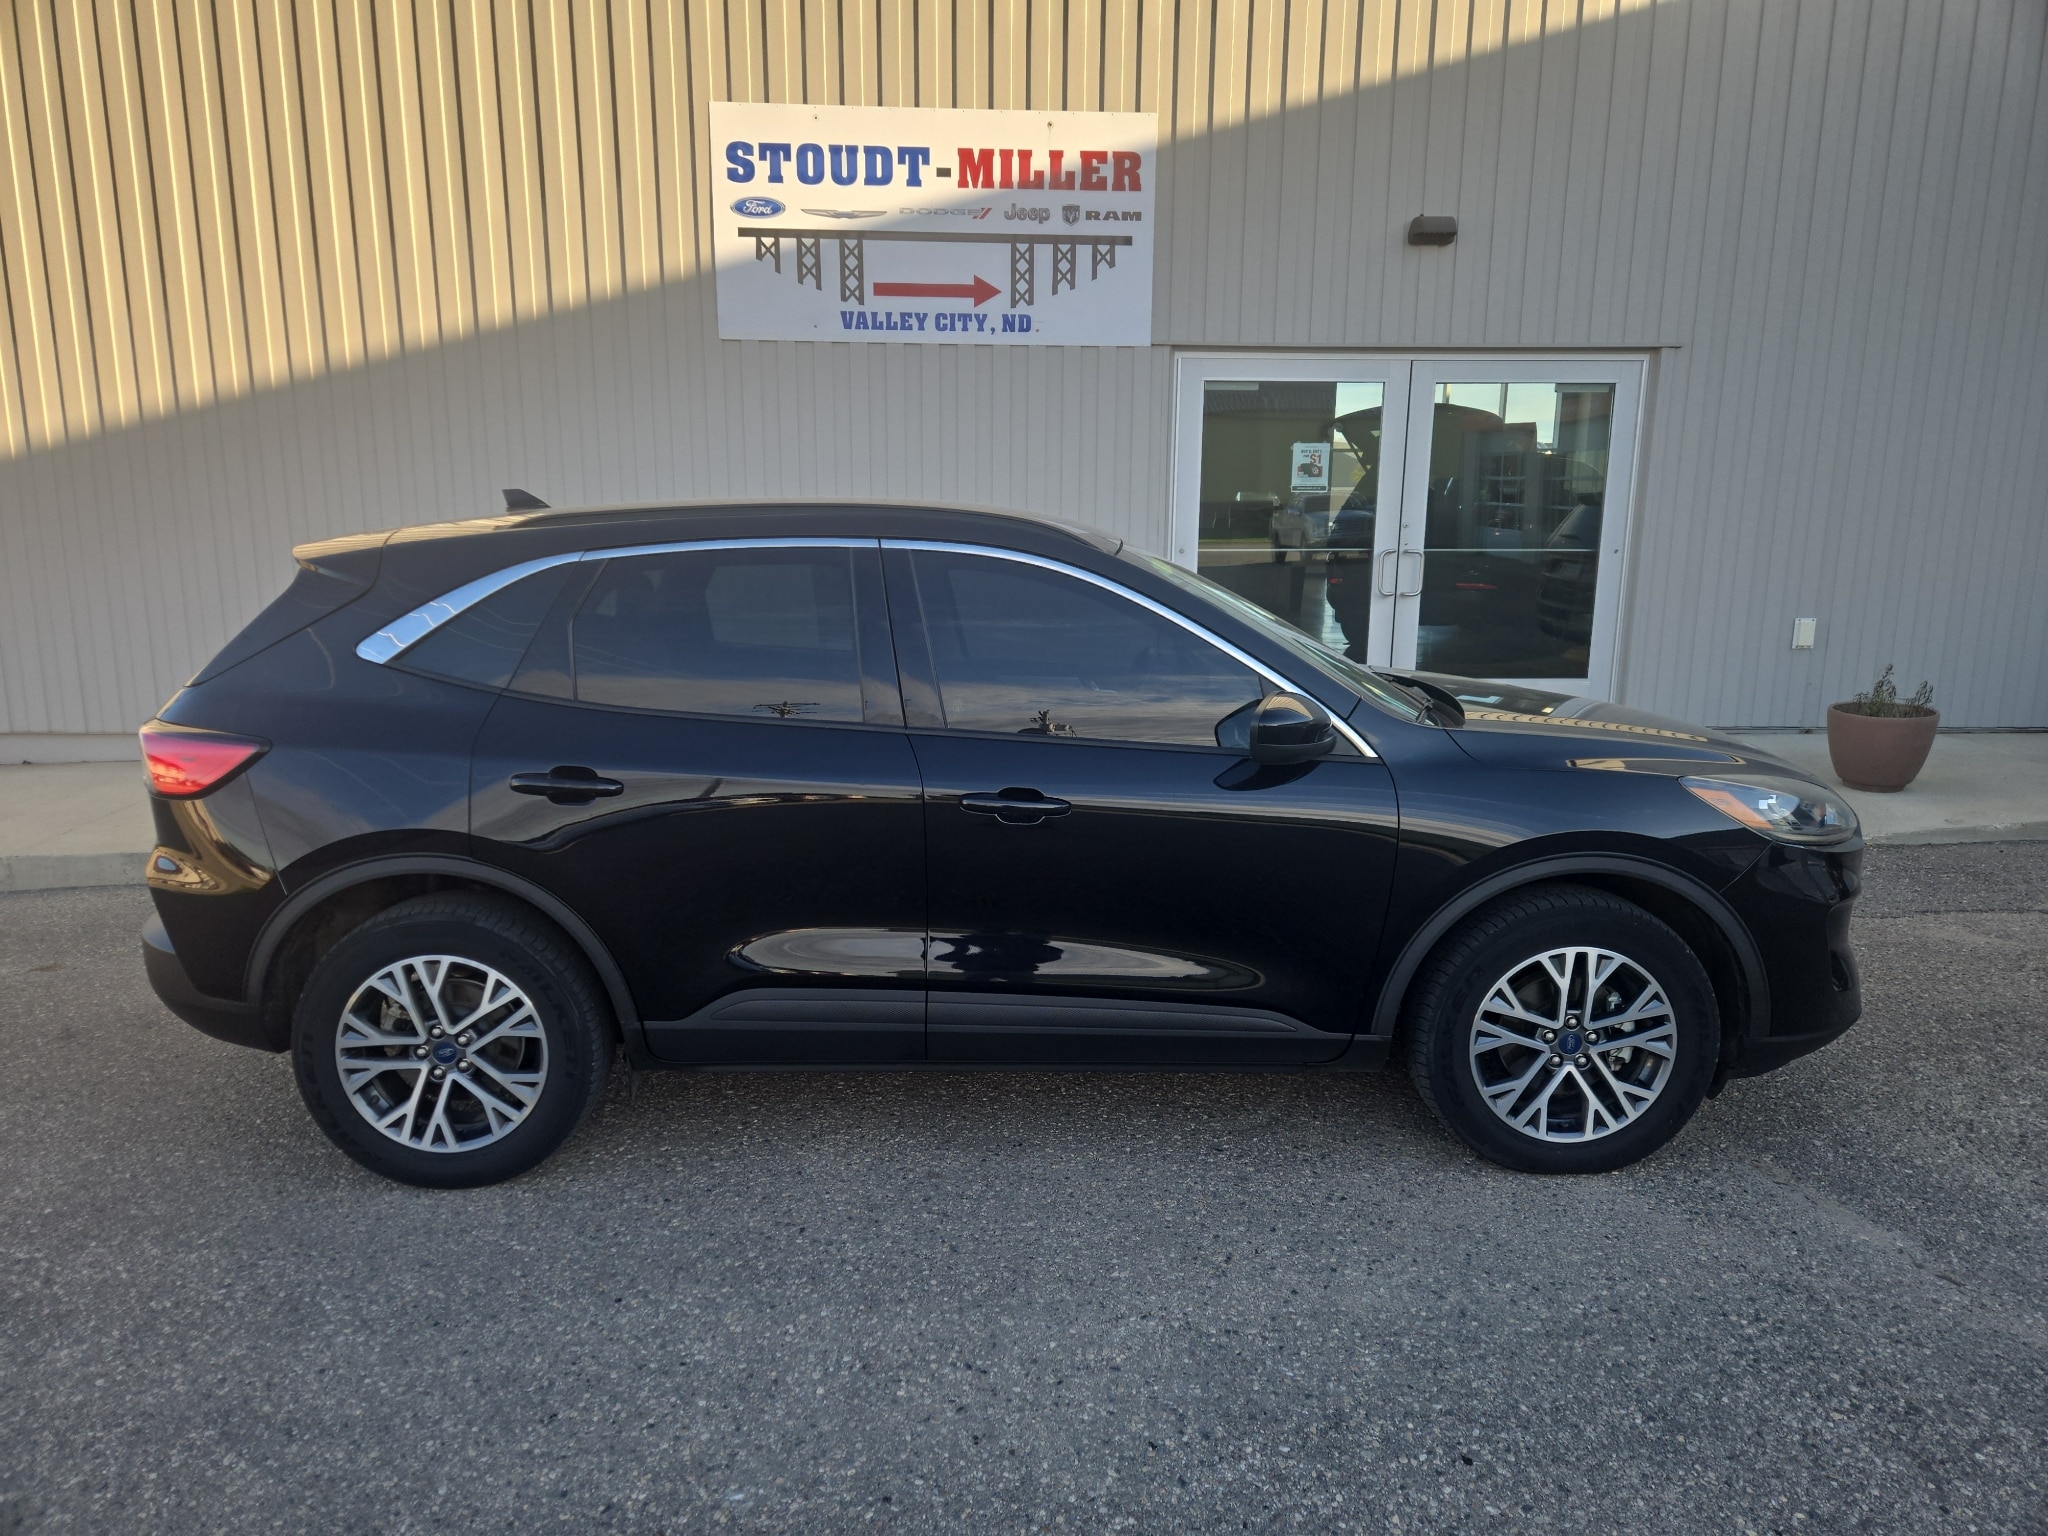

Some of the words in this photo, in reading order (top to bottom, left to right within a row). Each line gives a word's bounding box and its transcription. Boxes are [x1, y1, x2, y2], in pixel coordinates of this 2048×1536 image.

[725, 140, 1143, 192] STOUDT-MILLER
[899, 207, 983, 217] DODGE
[1003, 203, 1051, 225] Jeep
[1085, 210, 1142, 222] RAM
[840, 310, 928, 331] VALLEY
[934, 312, 996, 335] CITY,
[1001, 313, 1032, 333] ND
